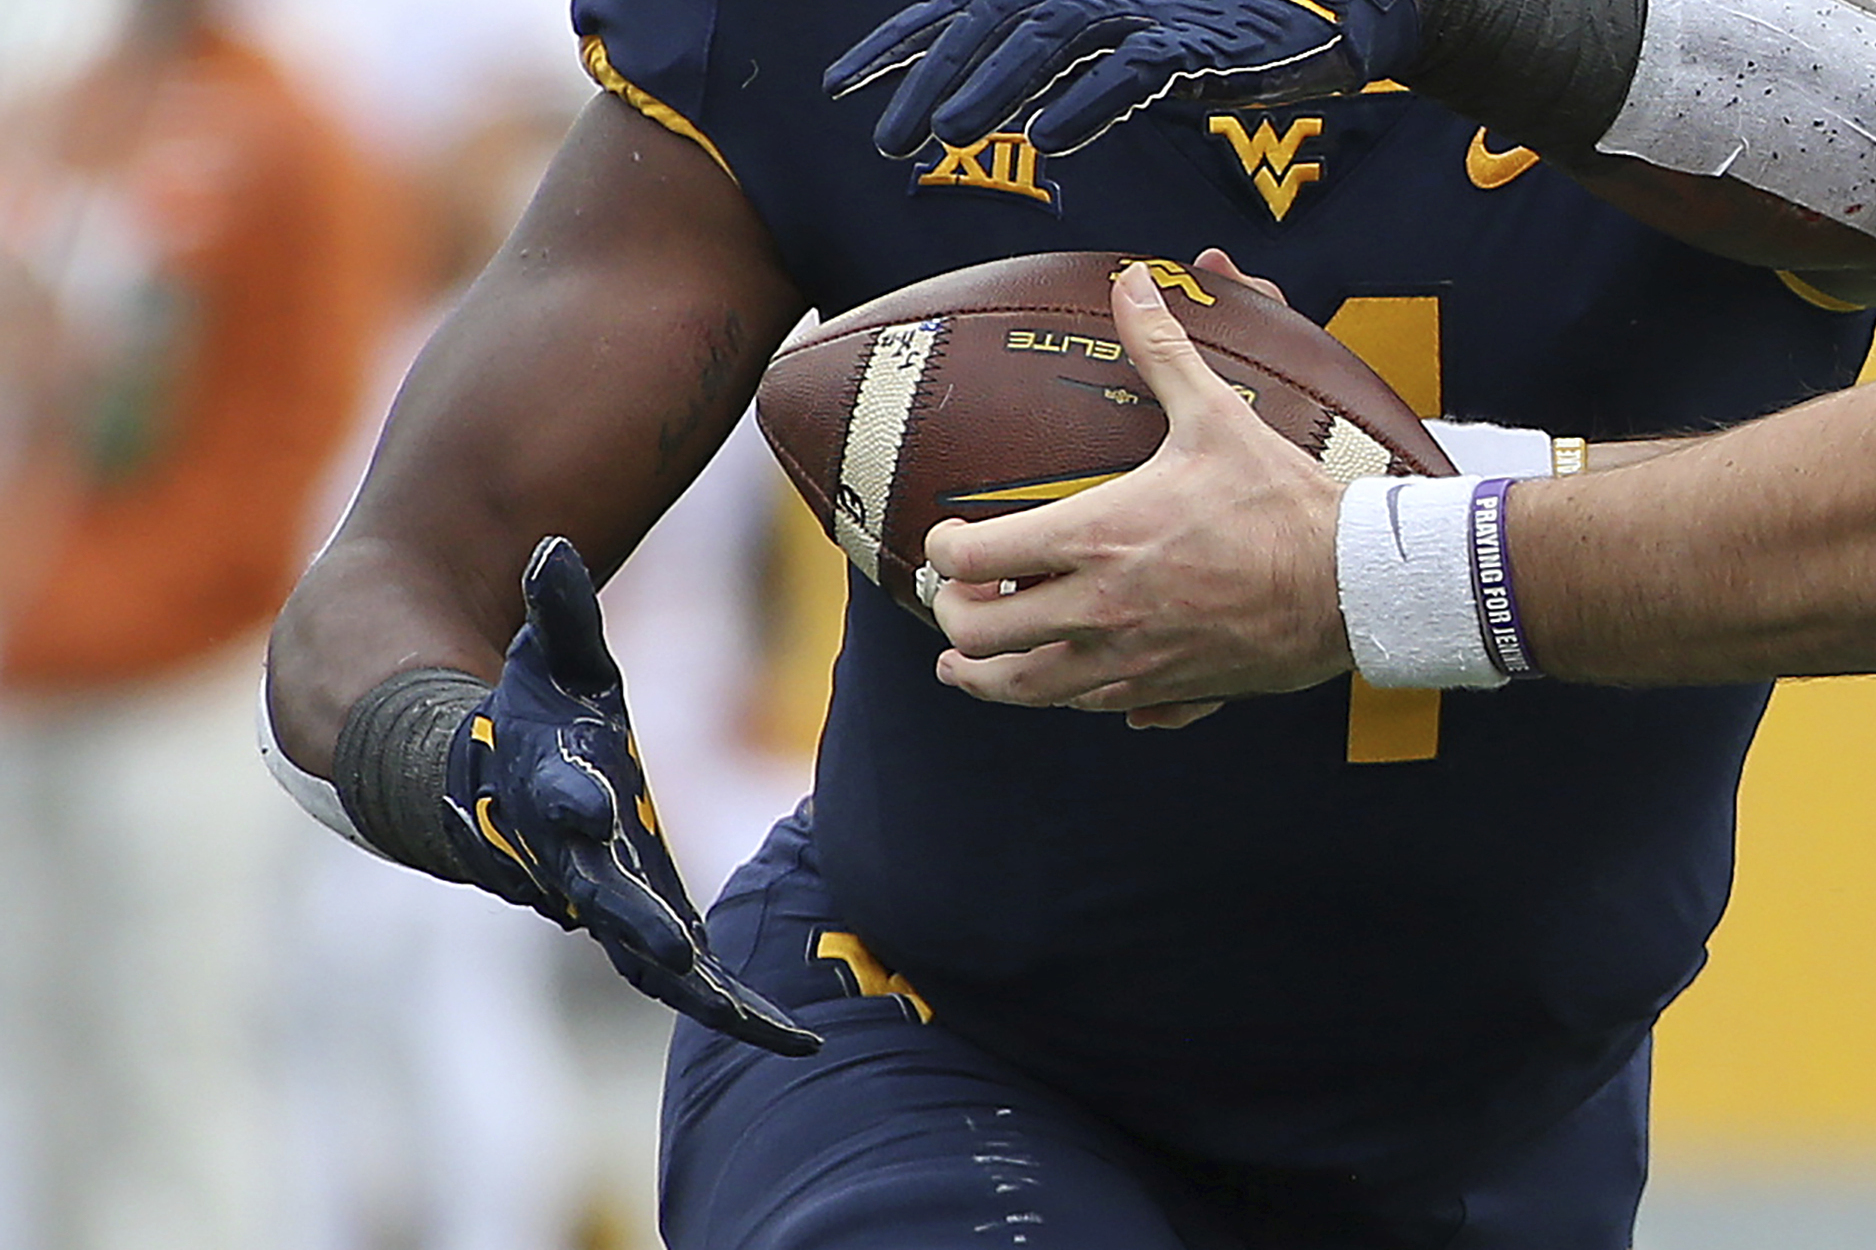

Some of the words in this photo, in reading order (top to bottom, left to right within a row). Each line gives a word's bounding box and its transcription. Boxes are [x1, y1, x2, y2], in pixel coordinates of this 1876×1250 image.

[1007, 331, 1121, 361] ELITE
[1475, 495, 1503, 584] PRAYING
[1483, 586, 1514, 624] FOR
